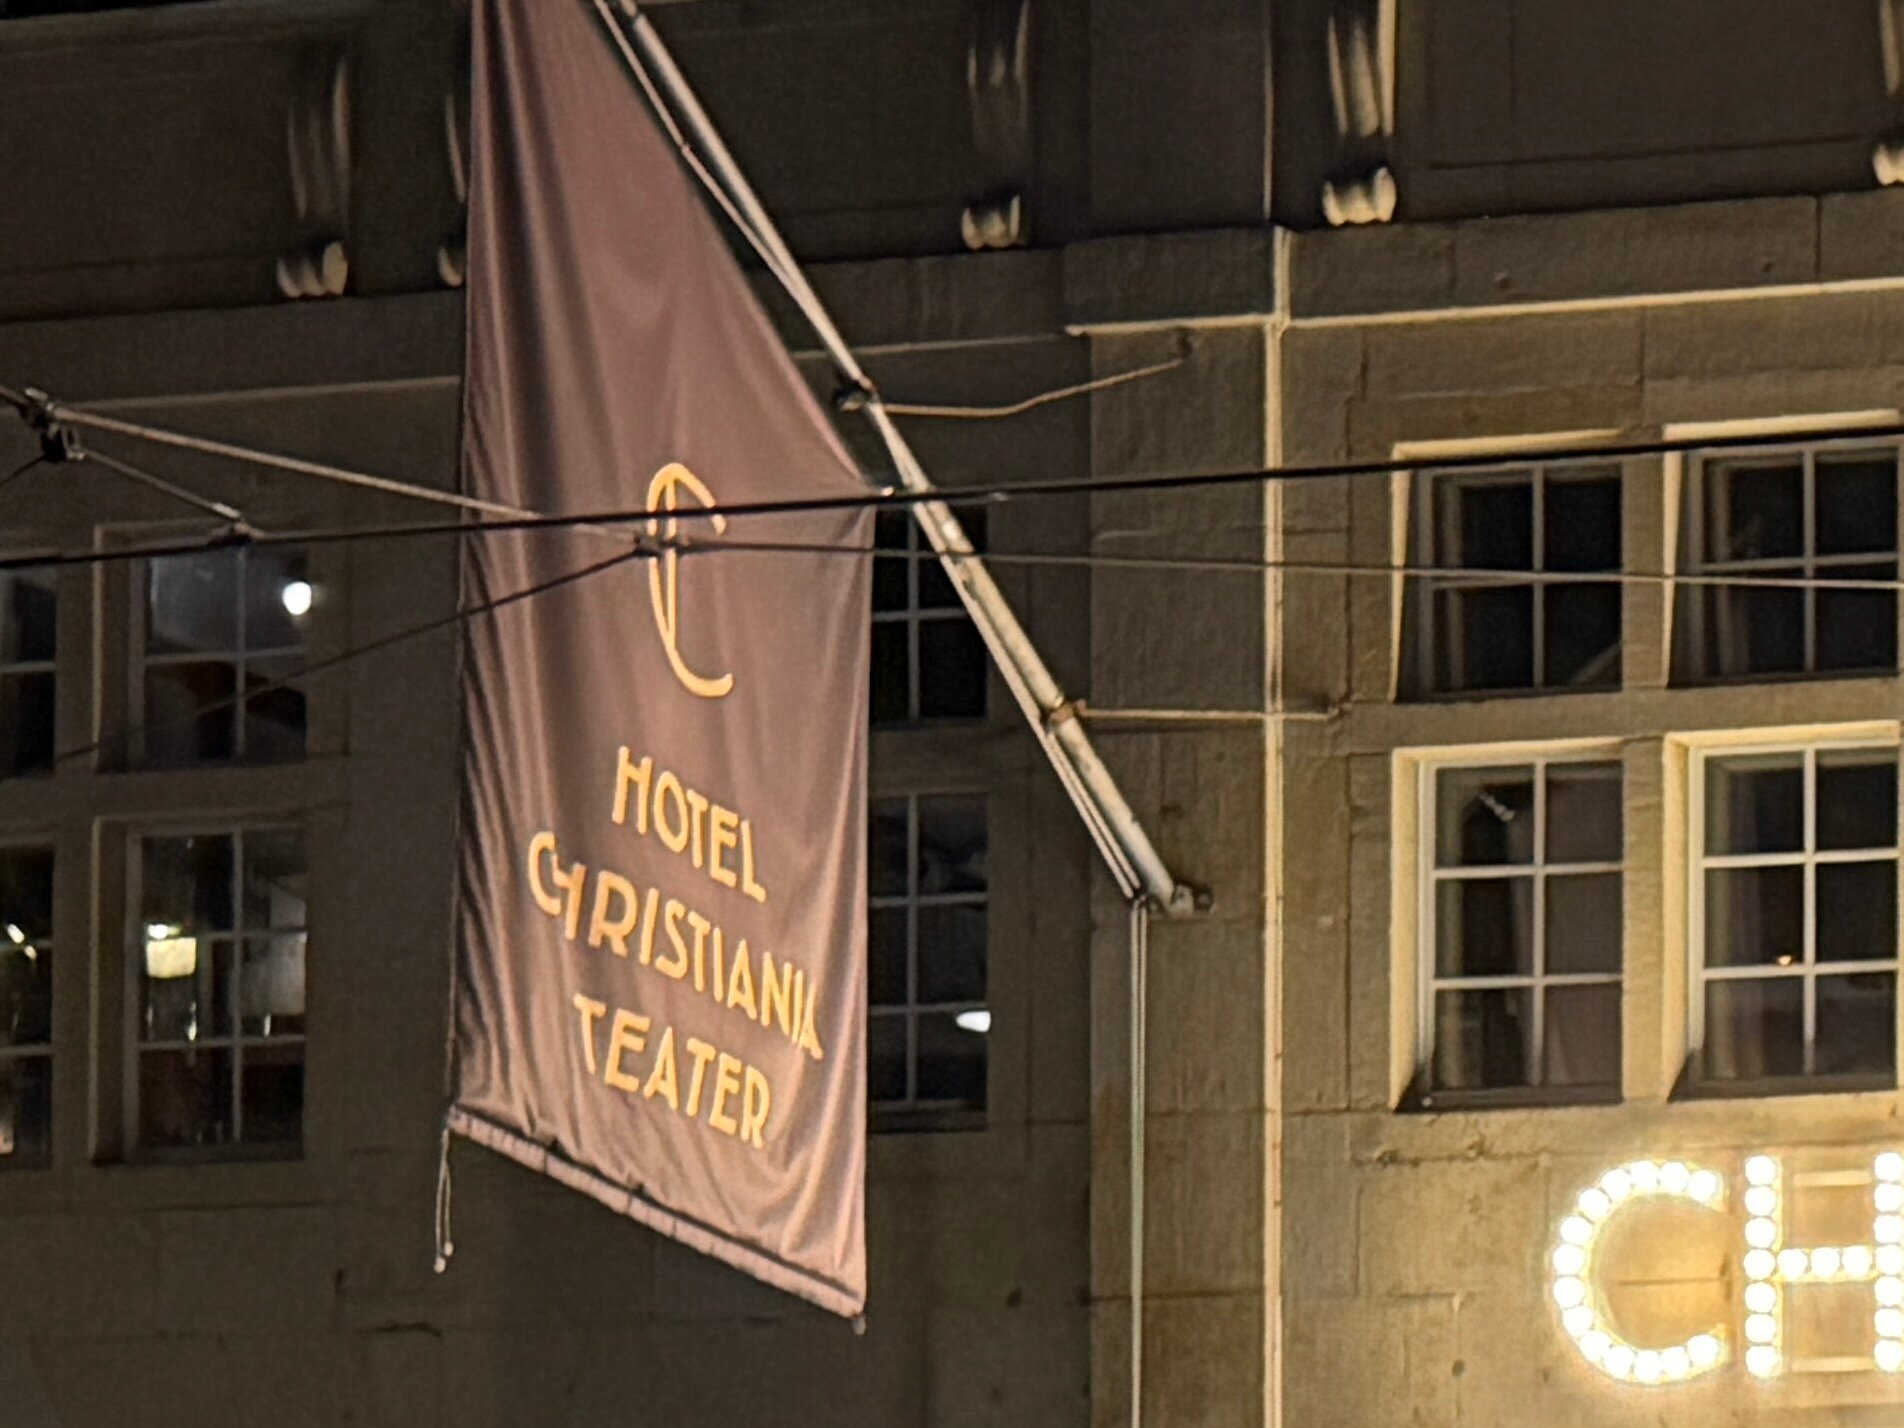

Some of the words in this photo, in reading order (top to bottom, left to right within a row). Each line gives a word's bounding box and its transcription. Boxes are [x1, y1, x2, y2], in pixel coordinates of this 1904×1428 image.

[611, 744, 767, 903] HOTEL
[528, 831, 823, 1059] CHRISTIANIA
[572, 992, 771, 1148] TEATER
